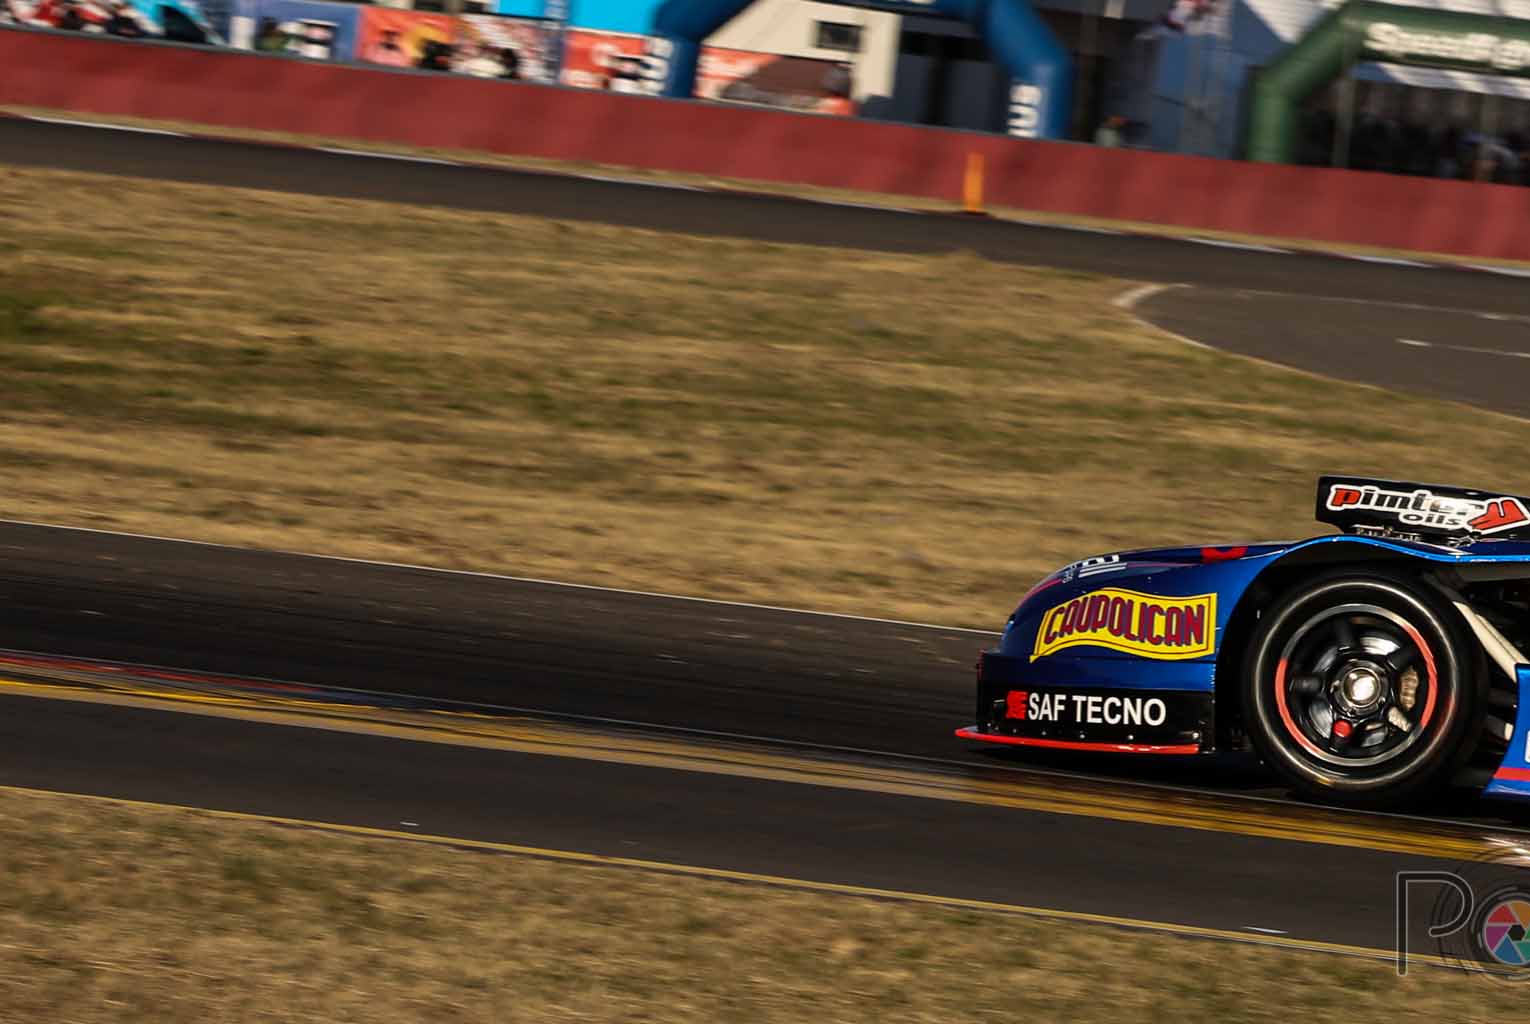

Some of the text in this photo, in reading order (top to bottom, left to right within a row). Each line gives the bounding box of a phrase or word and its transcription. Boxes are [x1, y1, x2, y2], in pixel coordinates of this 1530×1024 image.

[1043, 594, 1205, 648] CAUPOLICAN
[1028, 692, 1167, 727] SAF TECNO
